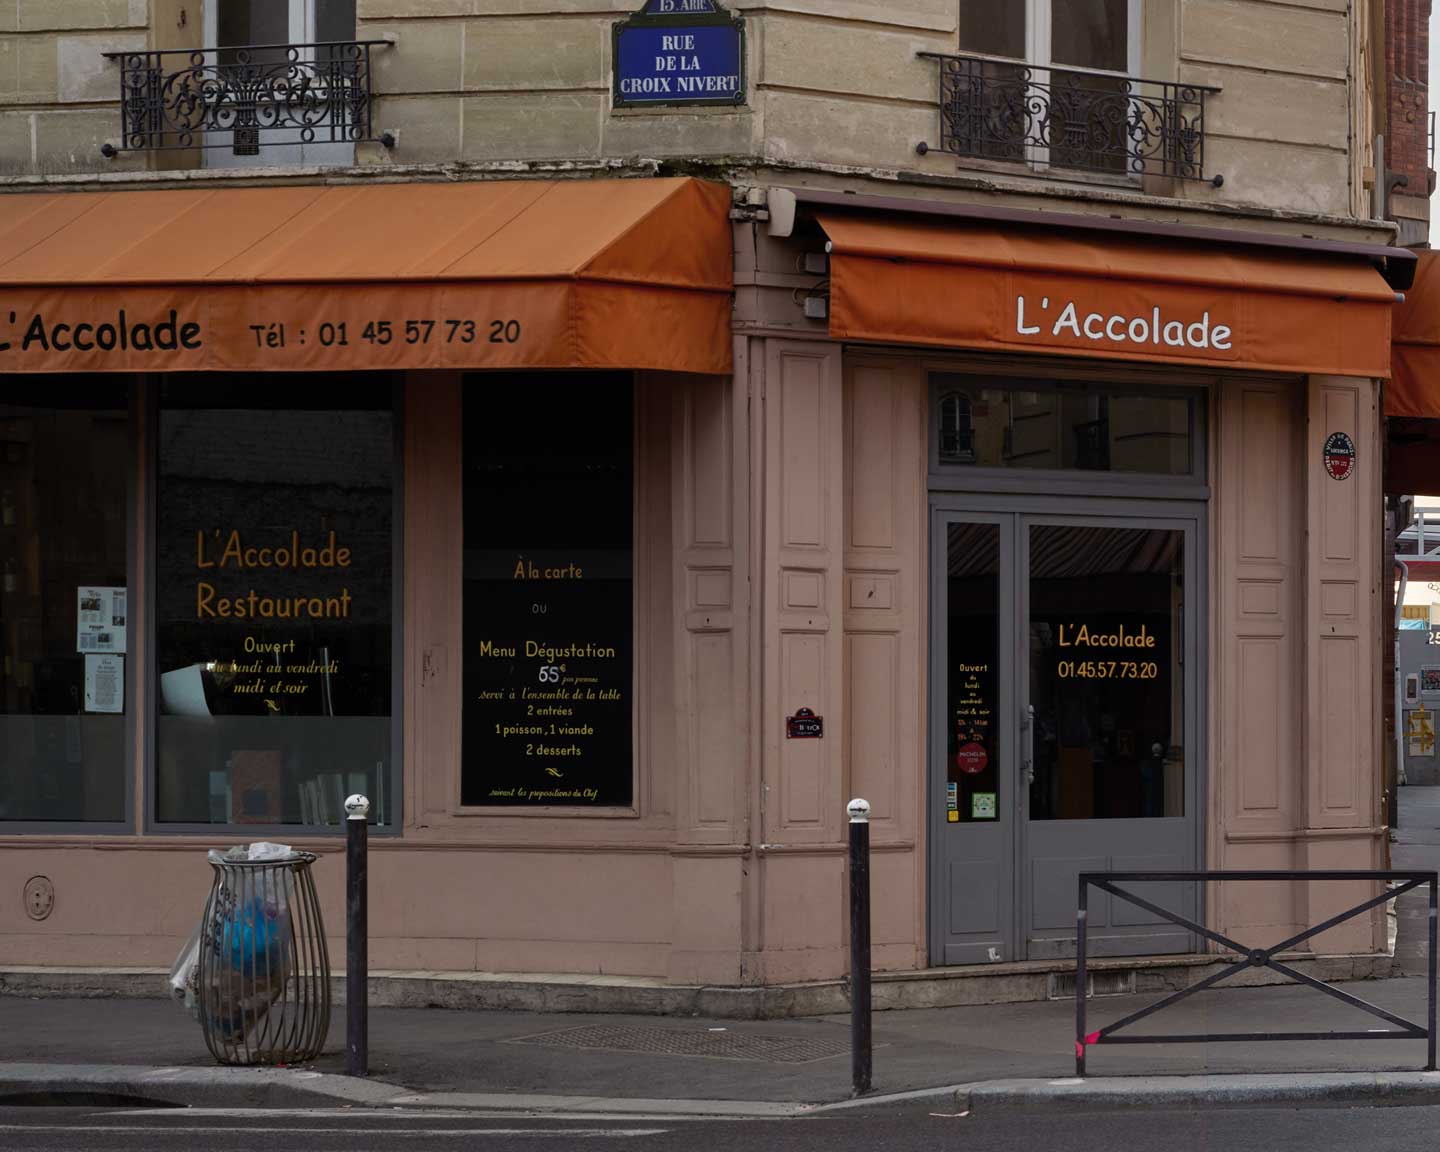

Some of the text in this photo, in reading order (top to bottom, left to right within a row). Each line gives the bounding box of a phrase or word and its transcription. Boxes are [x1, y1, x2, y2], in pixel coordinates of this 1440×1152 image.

[662, 35, 695, 51] RUE
[655, 55, 701, 71] DE LA
[620, 75, 738, 93] CROIX NIVERT
[0, 309, 202, 351] 'Accolade
[249, 323, 285, 348] Tél
[318, 322, 349, 346] 01
[361, 321, 393, 345] 45
[405, 320, 435, 344] 57
[445, 319, 476, 344] 73
[488, 319, 521, 343] 20
[1016, 296, 1232, 350] L'Accolade
[196, 529, 351, 568] L'Accolade
[528, 560, 539, 579] la
[544, 562, 583, 579] carte
[197, 582, 352, 618] Restaurant
[1059, 623, 1156, 648] L'Accolade
[244, 636, 296, 653] Ouvert
[480, 640, 616, 663] Menu Dégustation
[229, 659, 263, 674] lundi
[266, 664, 281, 674] au
[286, 659, 339, 674] vendredi
[959, 663, 988, 673] Ouvert
[1058, 660, 1158, 679] 01.45.57.73.20
[234, 678, 309, 694] midi et soir
[478, 688, 504, 700] servi
[521, 687, 570, 700] l'ensemble
[572, 689, 584, 700] de
[586, 688, 596, 700] la
[598, 689, 622, 700] table
[527, 705, 573, 716] 2 entrées
[558, 723, 594, 735] viande
[526, 744, 582, 756] 2 desserts
